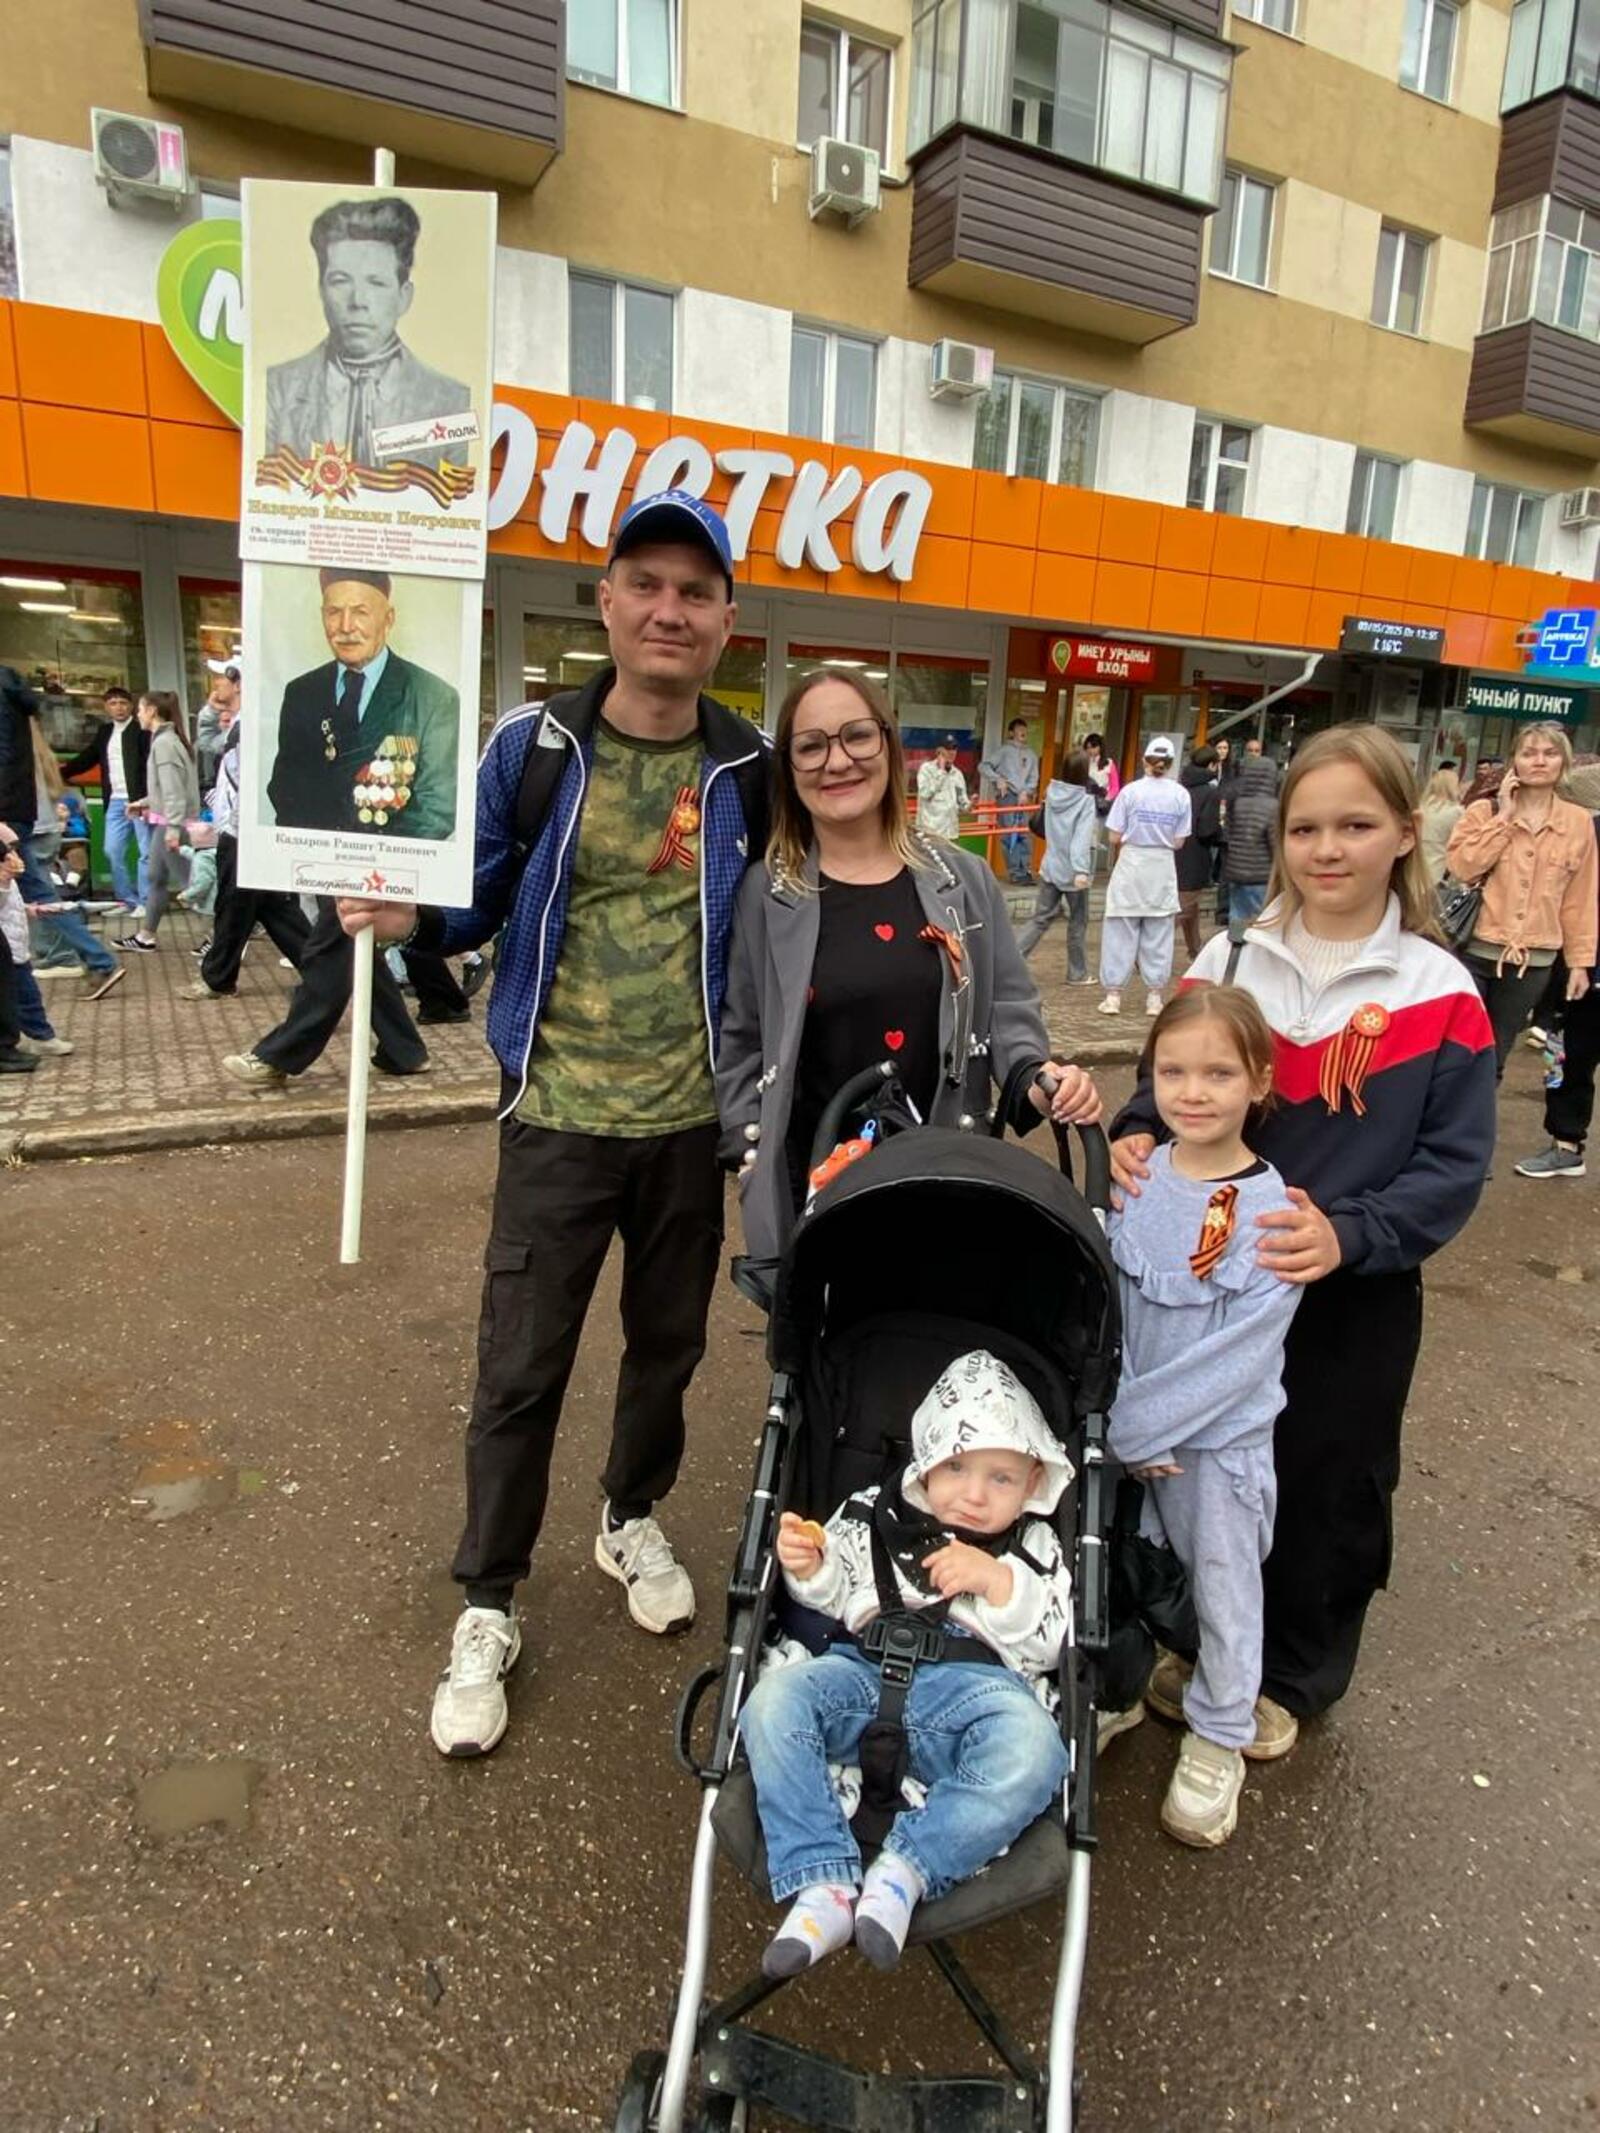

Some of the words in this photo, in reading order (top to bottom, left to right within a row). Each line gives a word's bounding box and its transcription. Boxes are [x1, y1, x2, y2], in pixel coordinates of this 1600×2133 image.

[396, 511, 481, 530] Петрович
[1096, 660, 1129, 677] ВХОД
[1523, 693, 1573, 715] ПУНКТ
[276, 832, 329, 848] Кадыров
[334, 837, 374, 852] Рашит
